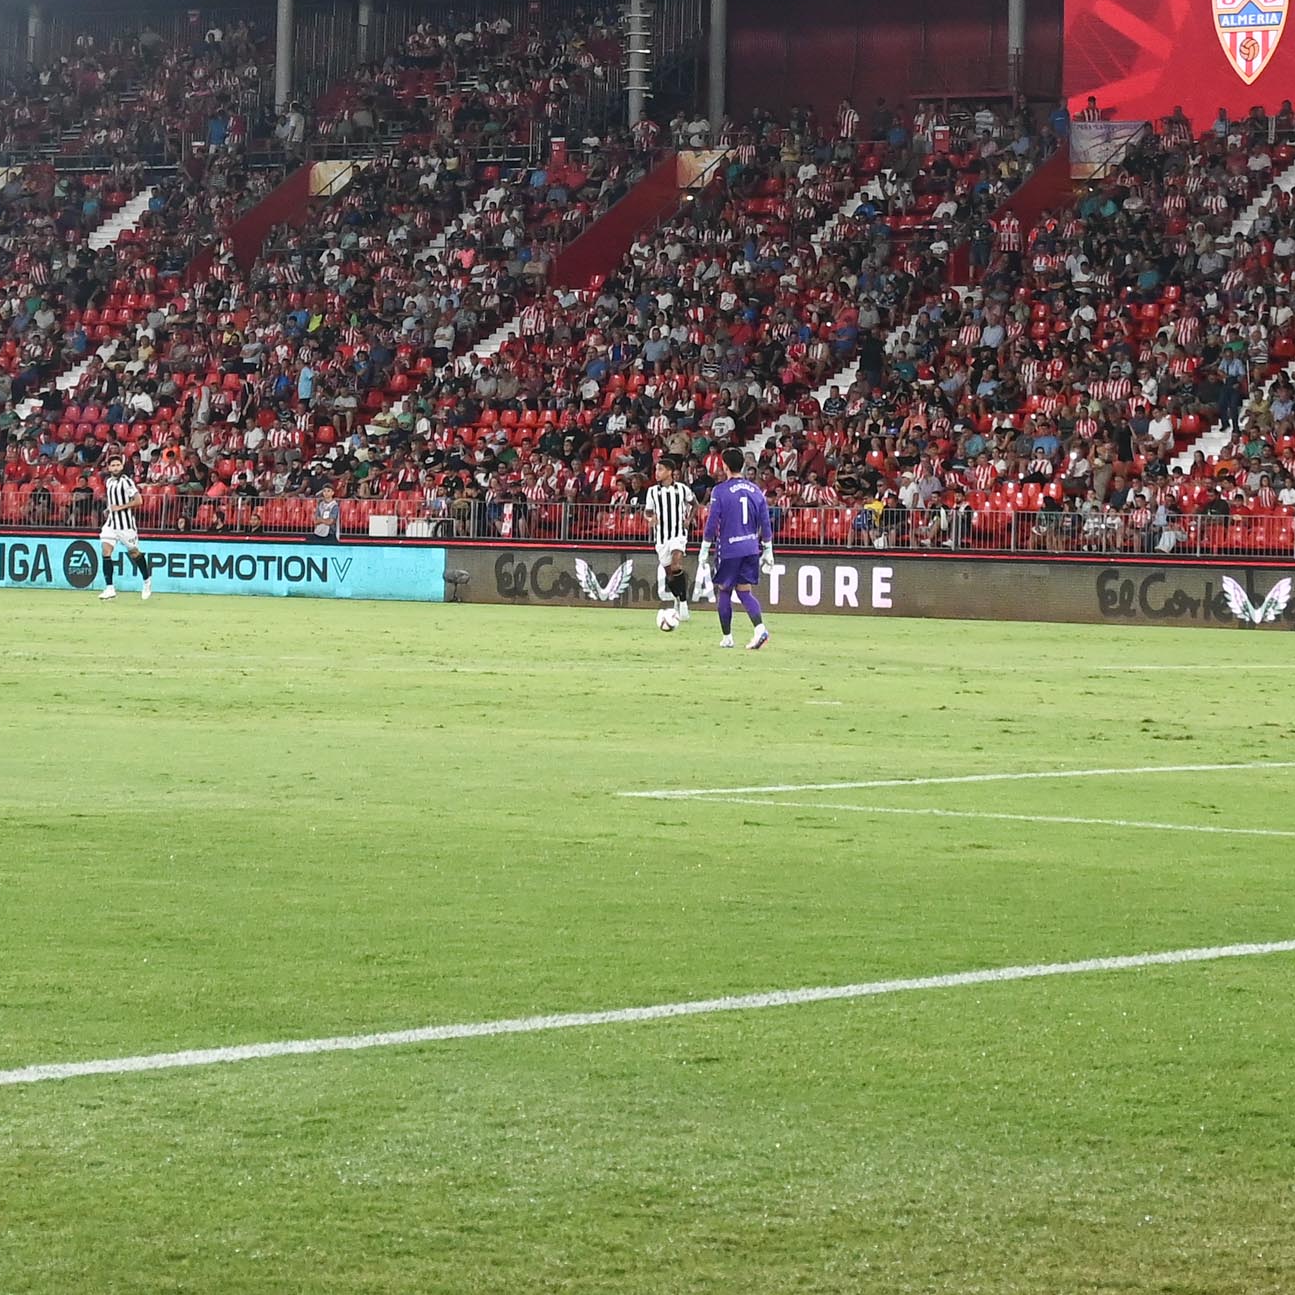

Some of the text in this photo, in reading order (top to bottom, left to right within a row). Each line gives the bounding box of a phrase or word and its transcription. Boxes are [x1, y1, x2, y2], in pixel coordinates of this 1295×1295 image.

[1220, 12, 1279, 26] ALMERIA
[739, 496, 748, 525] 1
[69, 550, 92, 567] EA
[657, 563, 893, 609] CATORE
